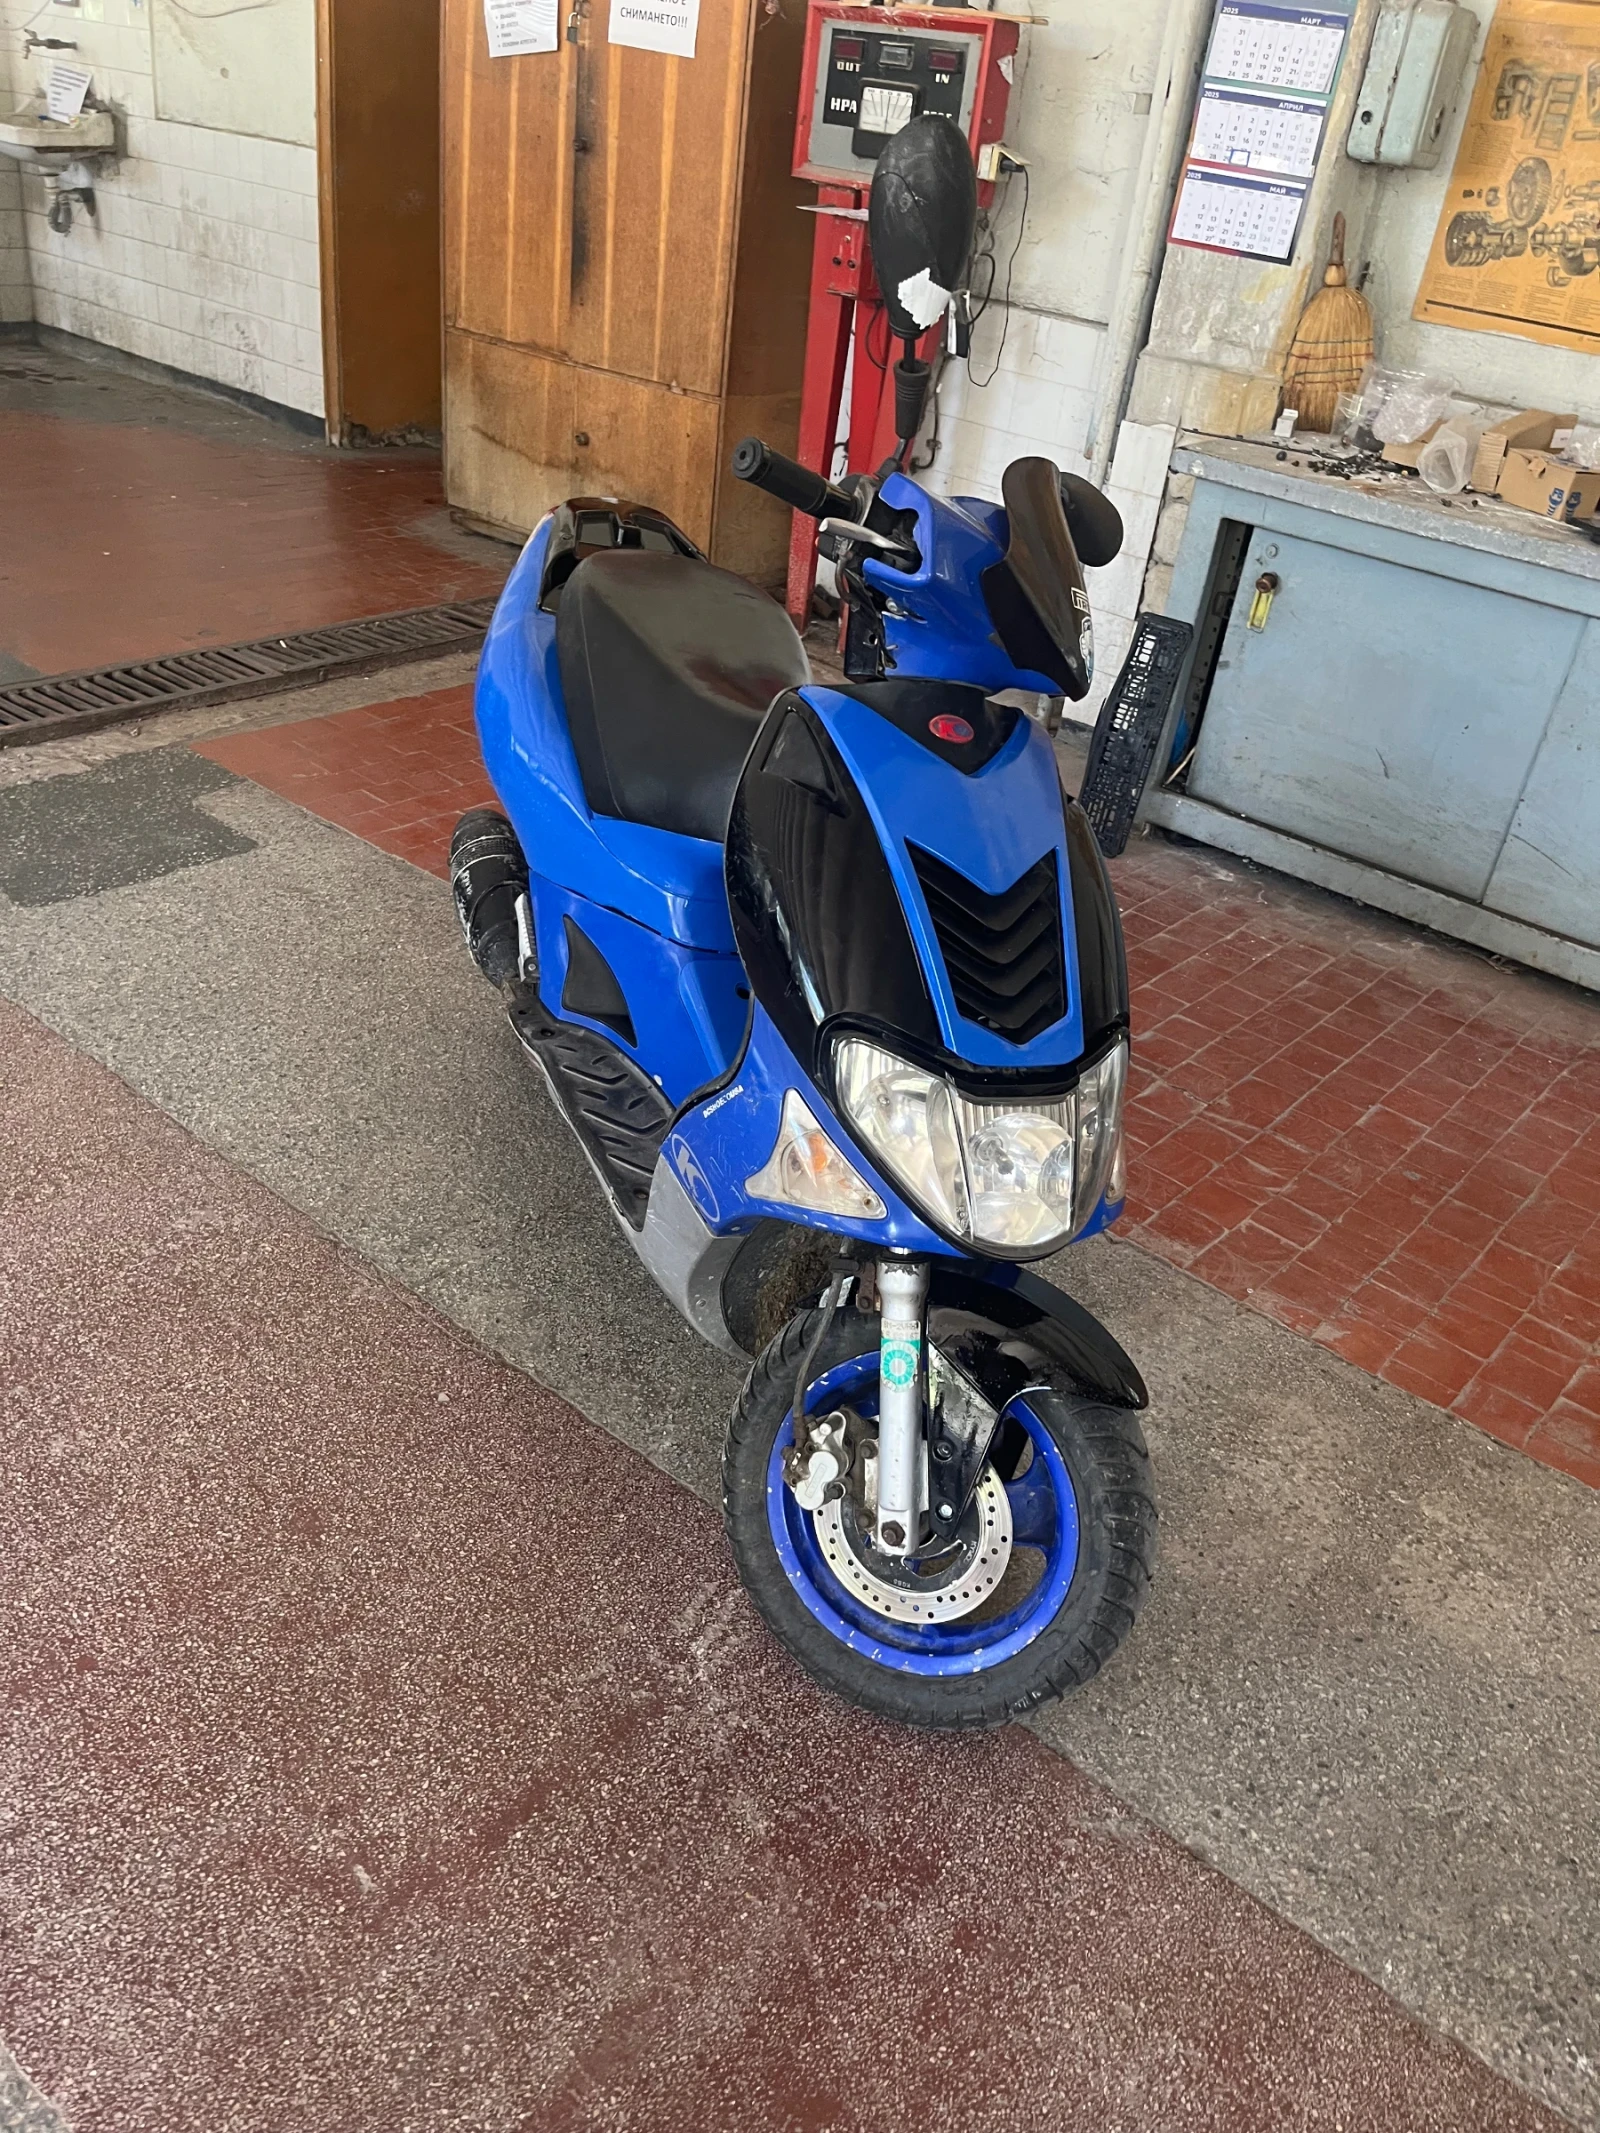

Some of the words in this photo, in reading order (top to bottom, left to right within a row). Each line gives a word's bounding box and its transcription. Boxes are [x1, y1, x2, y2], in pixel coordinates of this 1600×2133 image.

[620, 7, 688, 28] СНИМАНЕТО!!!
[1301, 17, 1321, 25] МАРТ
[837, 61, 861, 72] OUT
[935, 74, 950, 84] IN
[1204, 90, 1220, 98] 2025
[830, 97, 857, 113] HPA
[1279, 102, 1304, 111] АПРИЛ
[1269, 186, 1286, 194] МАЙ
